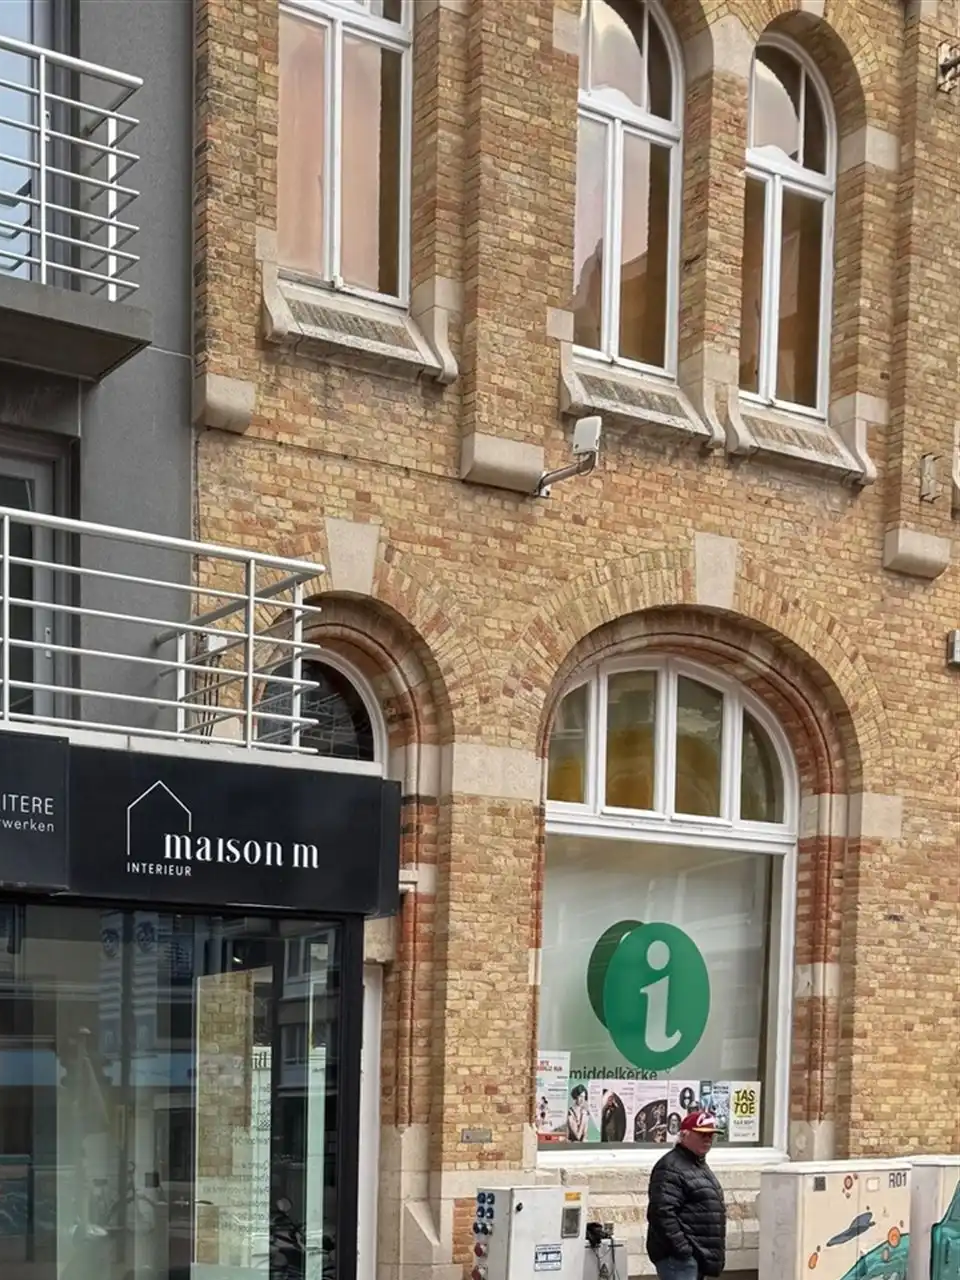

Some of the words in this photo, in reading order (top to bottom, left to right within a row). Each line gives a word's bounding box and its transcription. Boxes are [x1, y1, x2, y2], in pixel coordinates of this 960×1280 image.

[164, 833, 283, 866] maison
[292, 843, 319, 869] m
[127, 862, 192, 876] INTERIEUR
[569, 1066, 658, 1080] middelkerke
[734, 1089, 755, 1101] TAS
[734, 1102, 755, 1114] TOE
